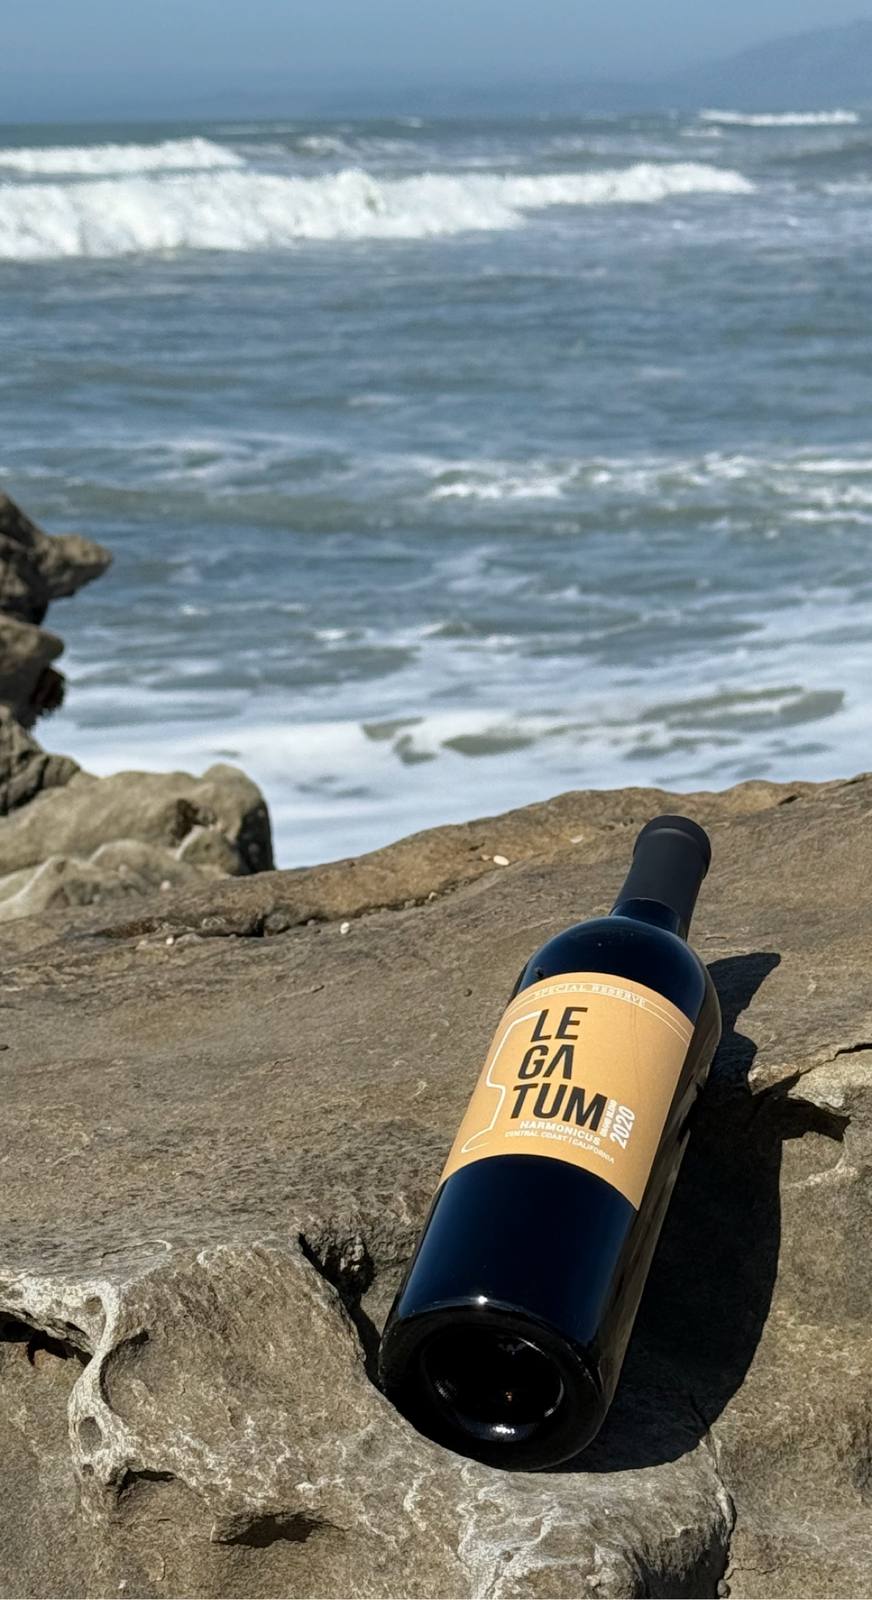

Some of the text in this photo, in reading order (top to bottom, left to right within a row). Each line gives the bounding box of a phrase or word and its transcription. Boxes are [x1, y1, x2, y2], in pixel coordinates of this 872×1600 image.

[535, 983, 646, 1007] SPECIAL RESERVE
[530, 1006, 588, 1042] LE
[517, 1044, 575, 1080] GA
[510, 1083, 608, 1131] TUM
[519, 1120, 601, 1145] HARMONICUS
[610, 1105, 635, 1149] 2020
